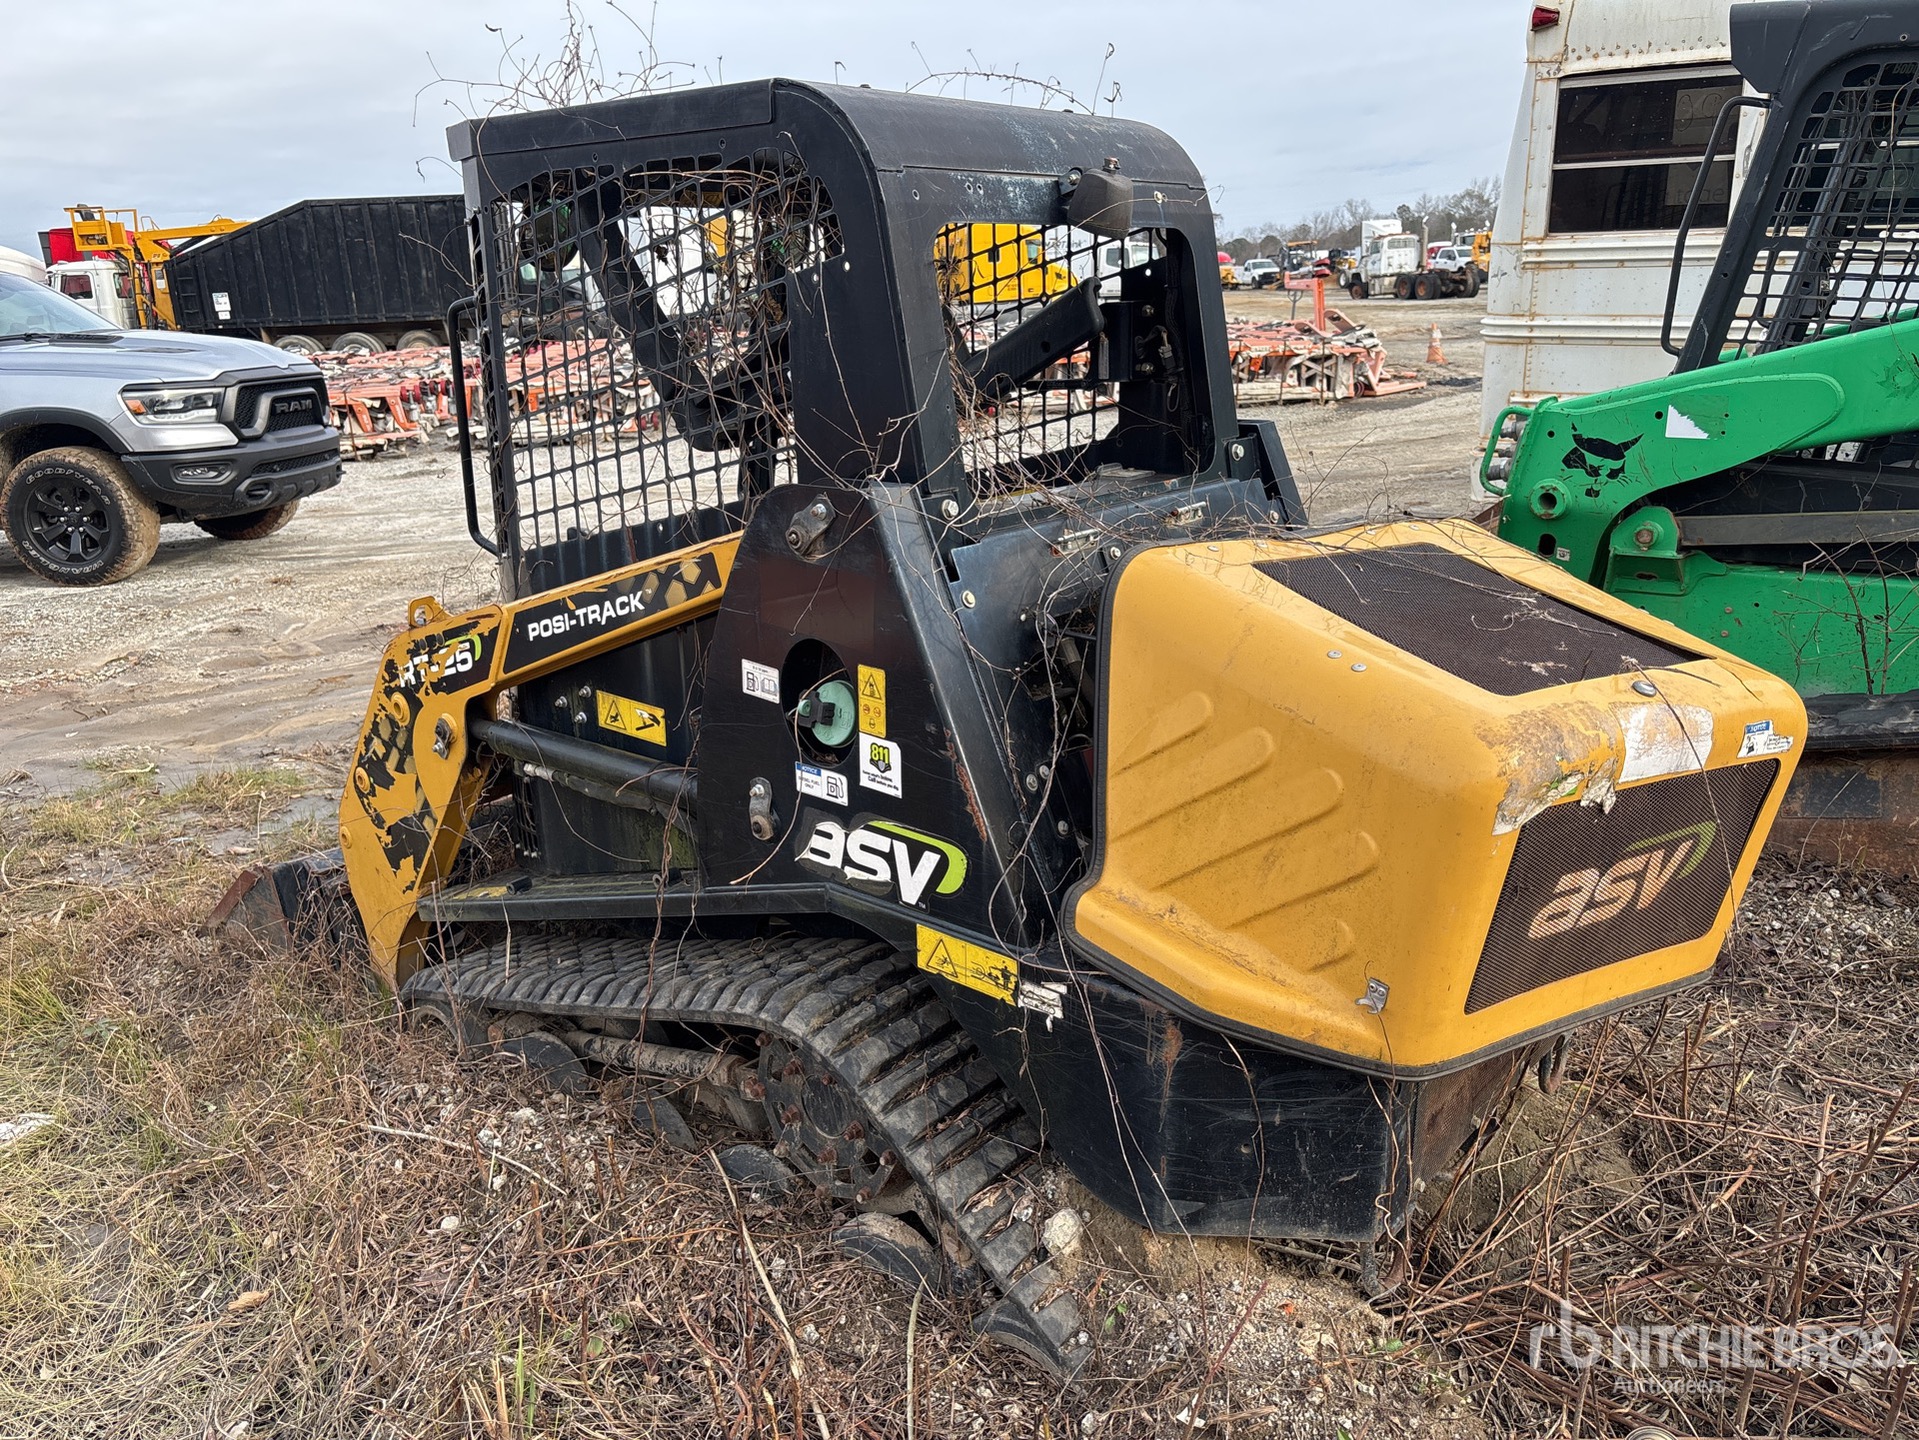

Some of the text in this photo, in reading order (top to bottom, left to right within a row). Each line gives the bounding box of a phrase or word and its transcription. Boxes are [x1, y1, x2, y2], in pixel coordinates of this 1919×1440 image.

[275, 399, 313, 414] RAM
[26, 468, 111, 505] GOODYEAR
[22, 540, 104, 575] WRANGLER
[528, 590, 645, 641] POSI-TRACK
[871, 743, 889, 764] 811
